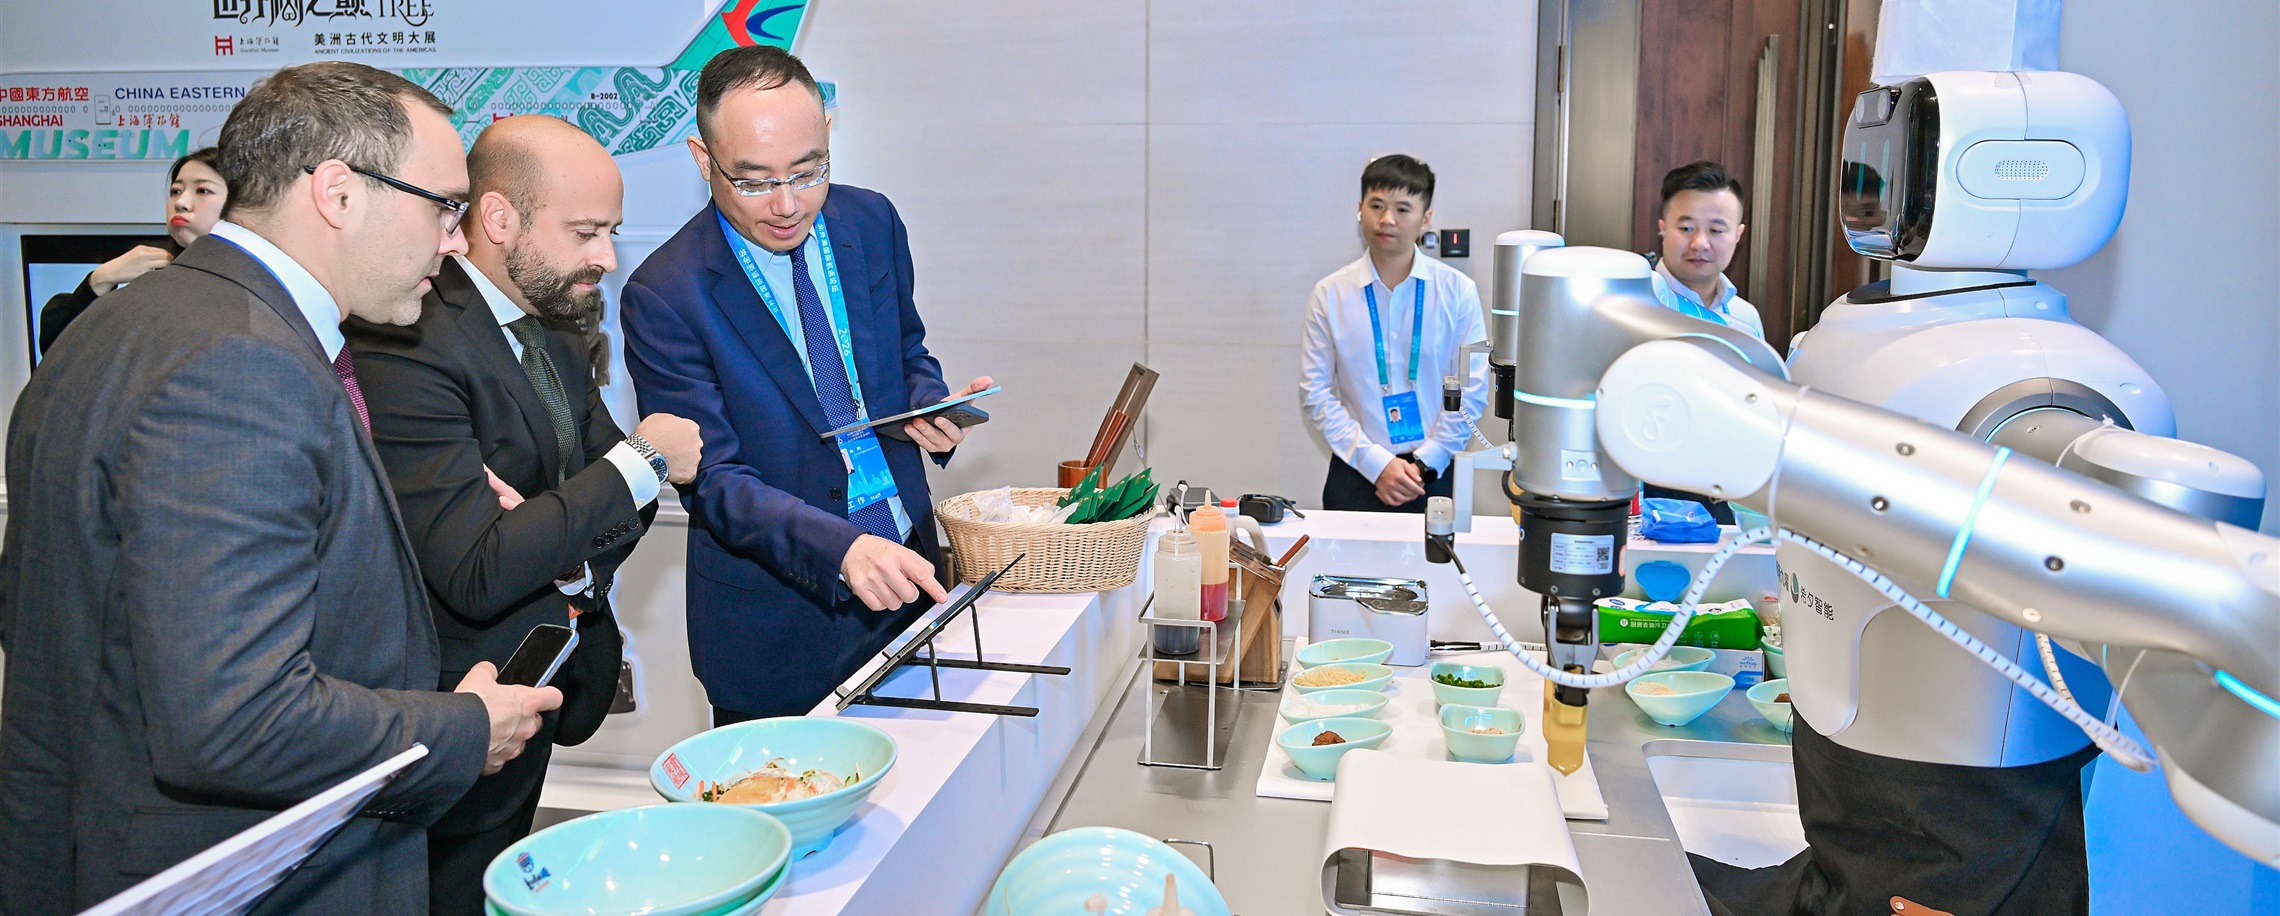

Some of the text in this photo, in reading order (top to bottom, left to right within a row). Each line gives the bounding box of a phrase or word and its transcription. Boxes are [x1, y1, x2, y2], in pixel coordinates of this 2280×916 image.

[314, 31, 436, 46] 美洲古代文明大展
[114, 86, 245, 100] CHINA EASTERN
[590, 92, 618, 100] B-2002
[0, 114, 63, 127] HANGHAI
[0, 129, 190, 160] MUSEUM
[837, 327, 851, 357] 2026
